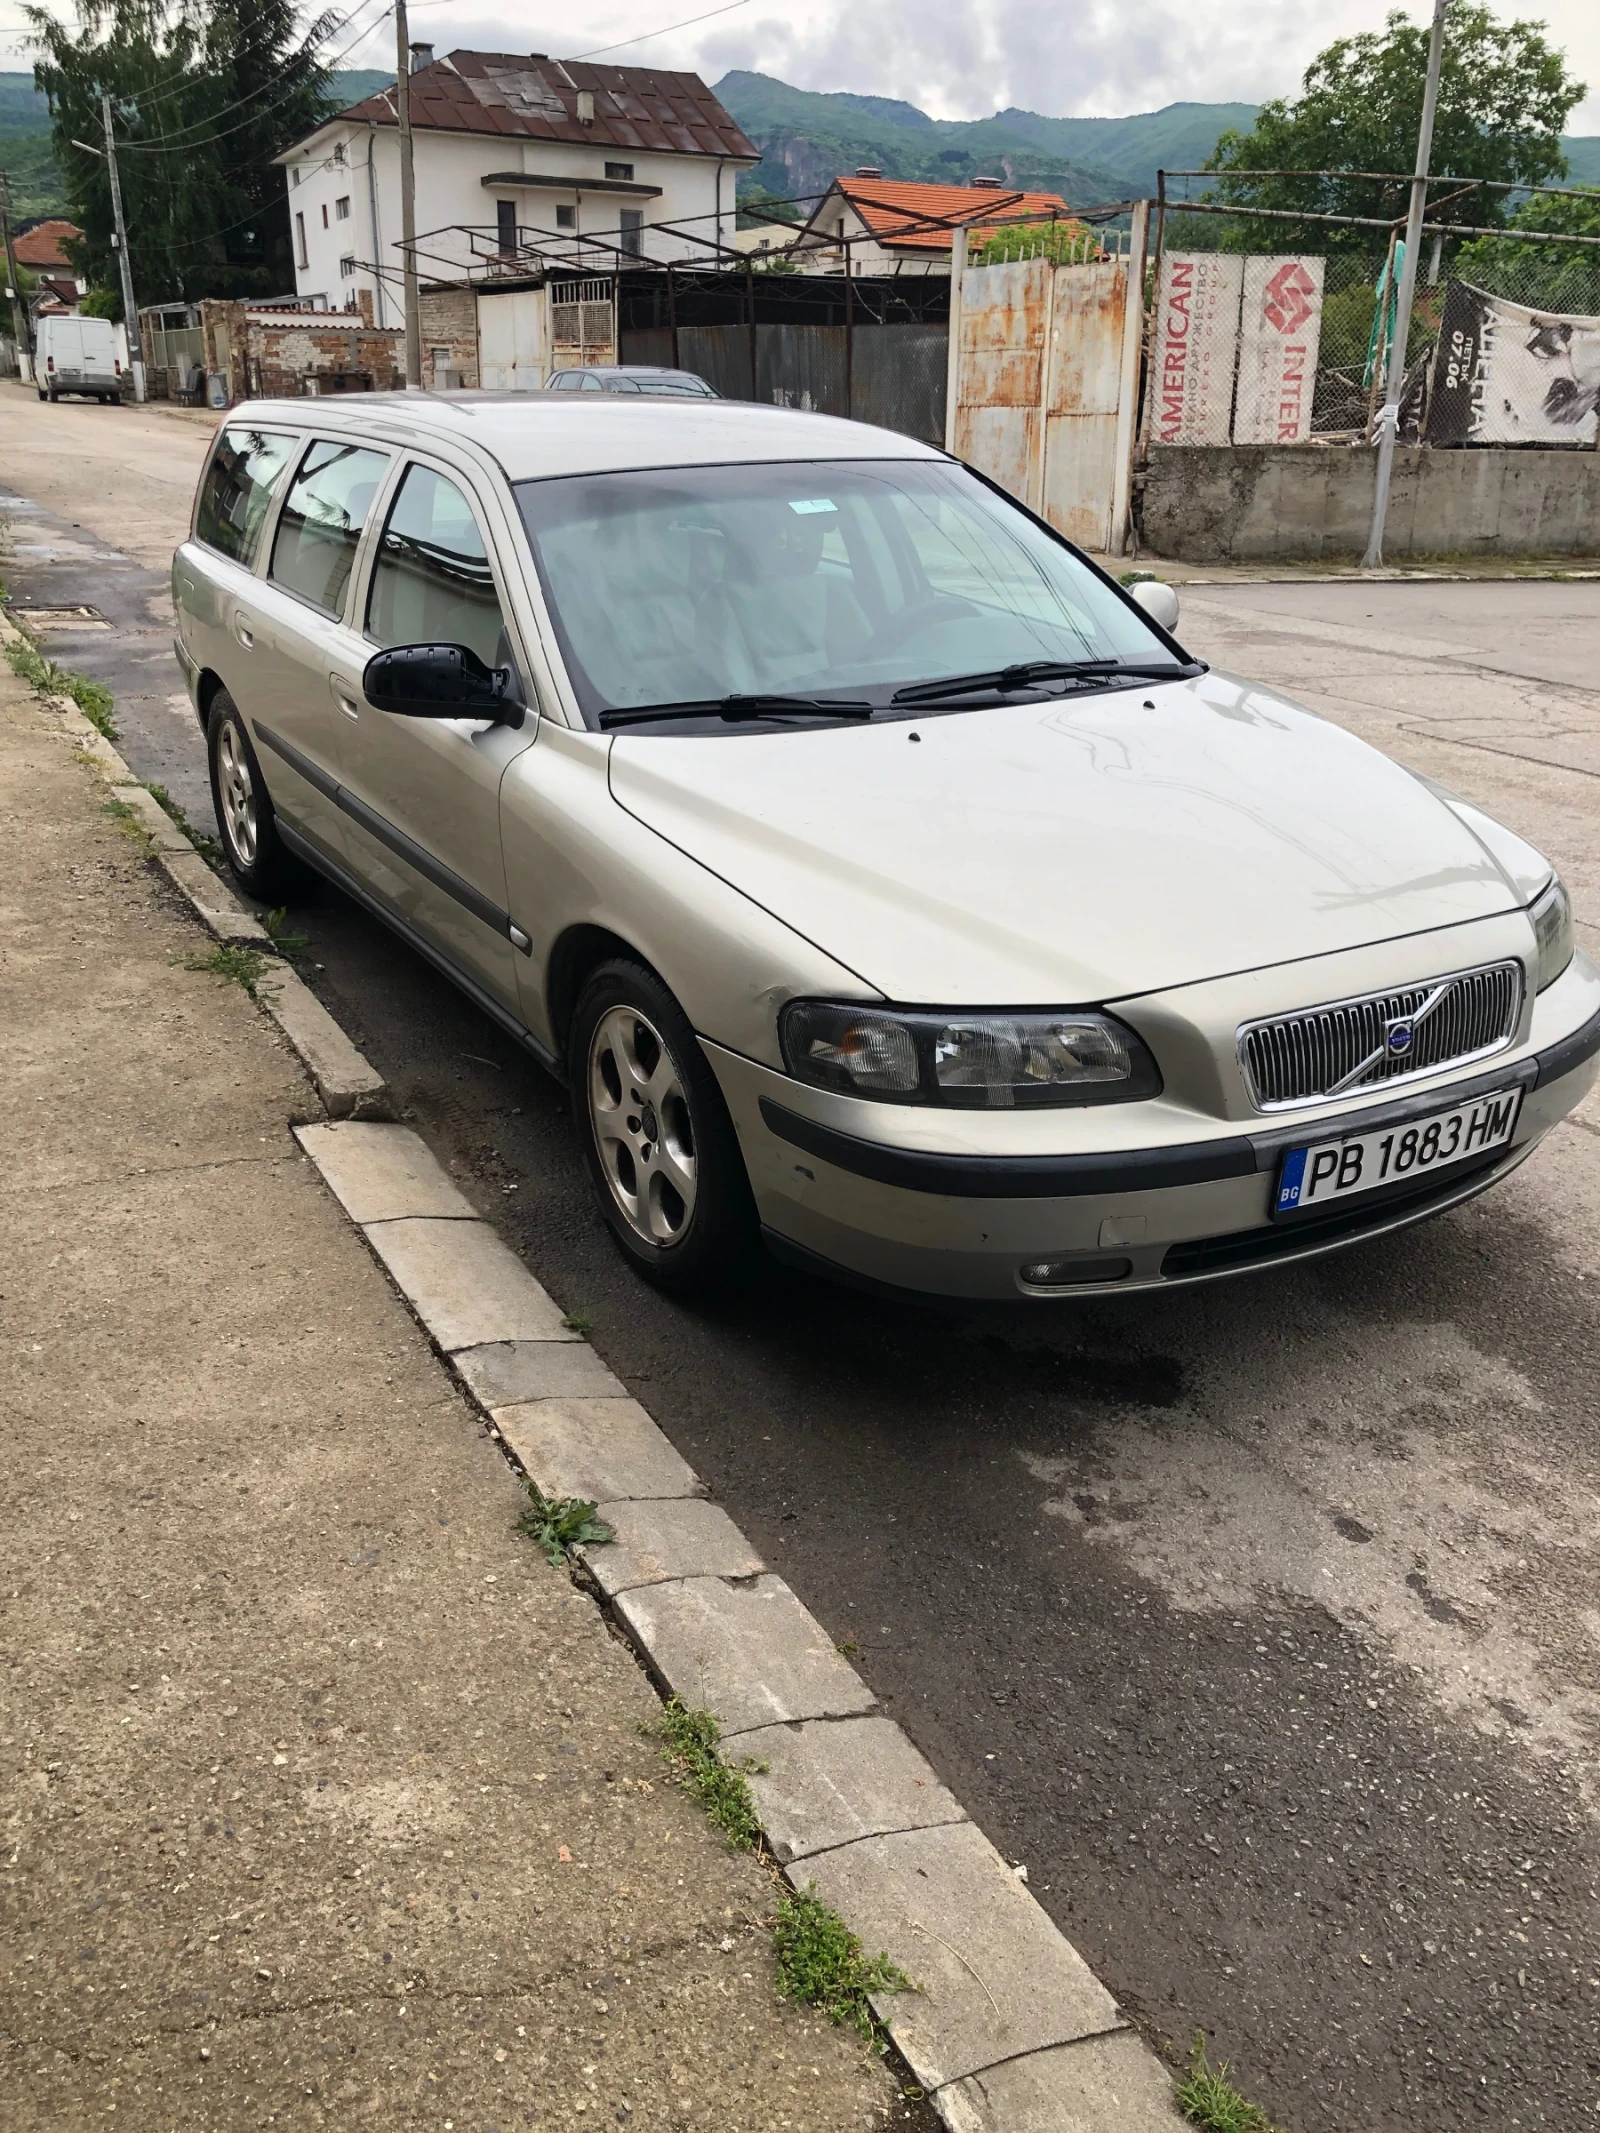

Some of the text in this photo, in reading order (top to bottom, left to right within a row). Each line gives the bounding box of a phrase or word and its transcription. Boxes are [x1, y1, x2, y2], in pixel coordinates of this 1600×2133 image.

[1160, 263, 1193, 443] AMERICAN
[1191, 264, 1208, 372] ДРУЖЕСТВО
[1196, 264, 1219, 436] EUREKO GROUP
[1446, 330, 1464, 389] 07.06
[1460, 337, 1474, 382] ПЕТЪК
[1277, 345, 1306, 441] INTER
[1281, 1186, 1300, 1202] BG
[1308, 1096, 1515, 1197] PB 1883 HM
